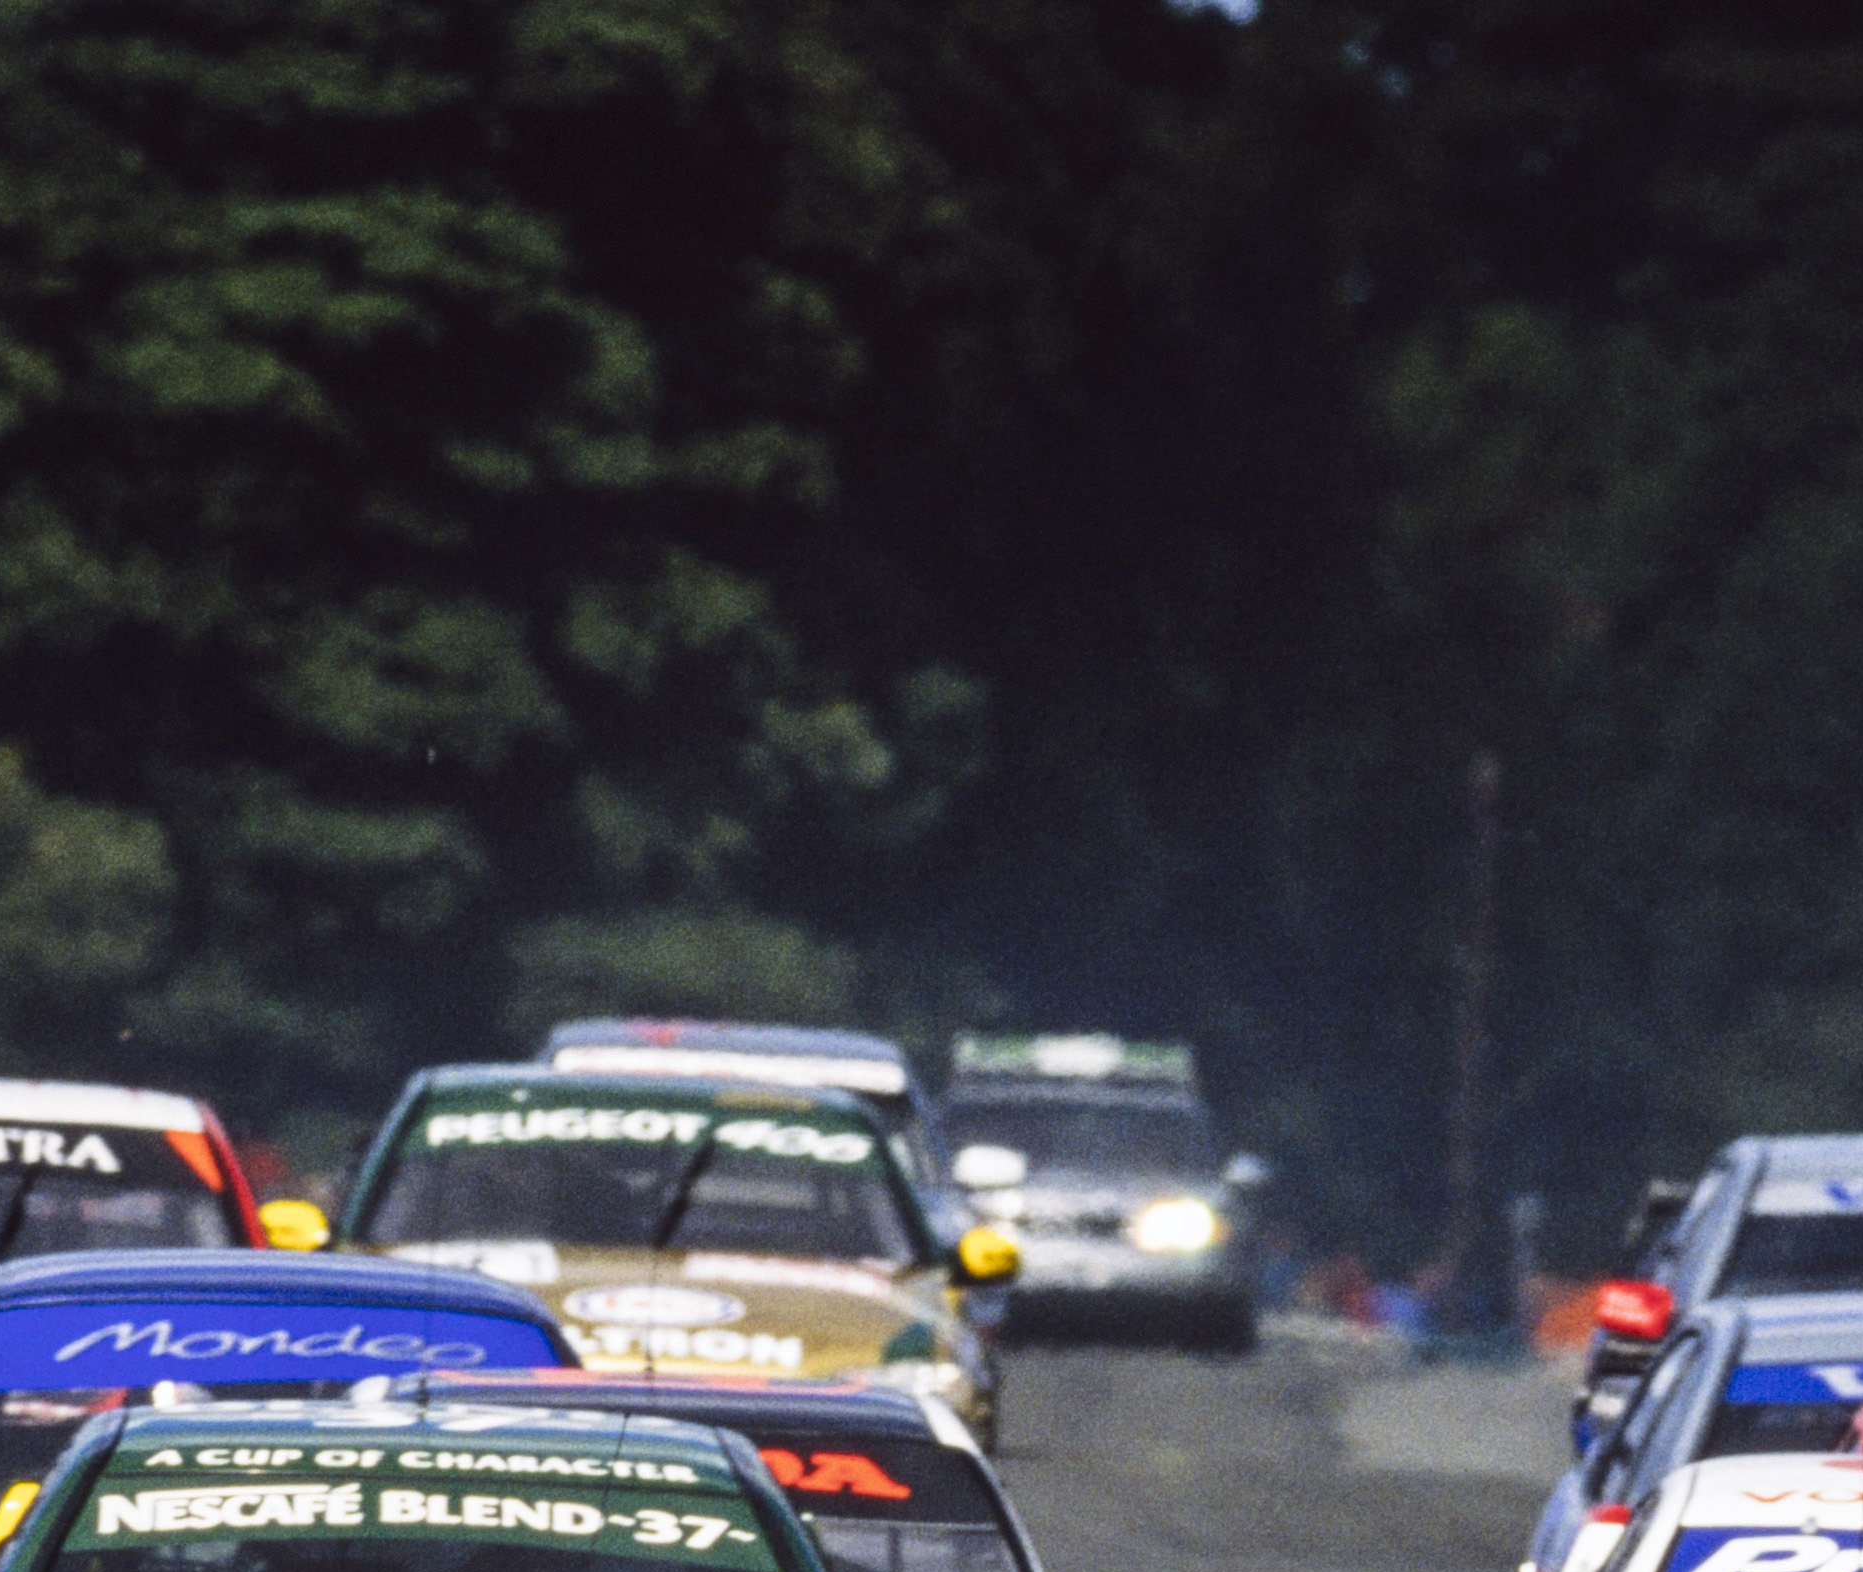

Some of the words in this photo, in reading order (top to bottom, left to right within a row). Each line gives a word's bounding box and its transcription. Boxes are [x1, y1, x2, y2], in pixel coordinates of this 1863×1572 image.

[427, 1109, 709, 1146] PEUGEOT
[54, 1319, 489, 1366] Mondeo
[146, 1449, 183, 1466] A
[195, 1448, 304, 1467] CUP
[314, 1449, 383, 1468] OF
[398, 1450, 698, 1484] CHARACTER
